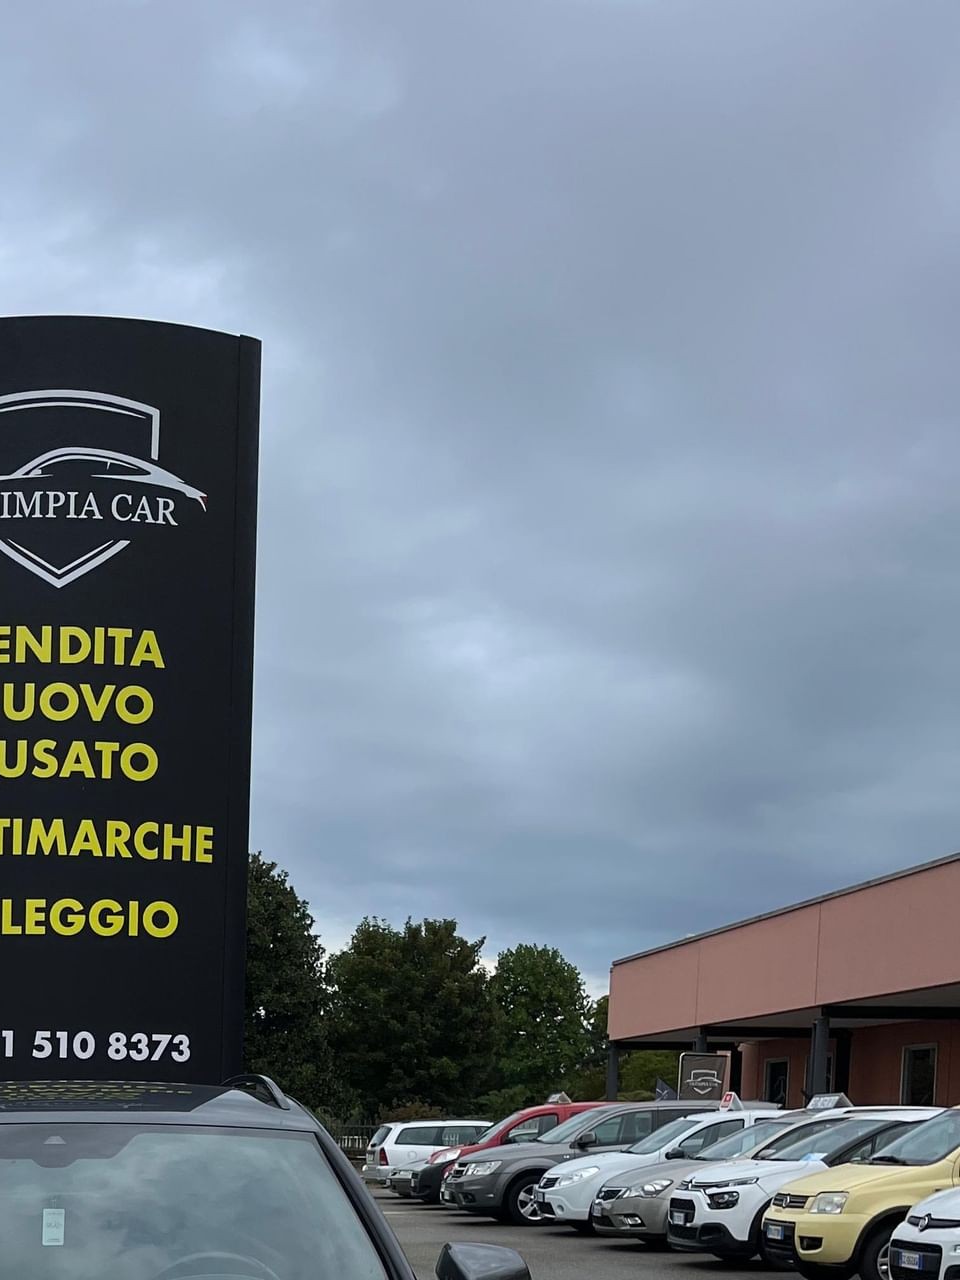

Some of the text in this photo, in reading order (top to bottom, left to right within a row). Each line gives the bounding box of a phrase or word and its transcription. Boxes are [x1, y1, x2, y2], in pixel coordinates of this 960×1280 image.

[111, 492, 179, 526] CAR
[32, 1030, 96, 1060] 510
[107, 1032, 191, 1063] 8373
